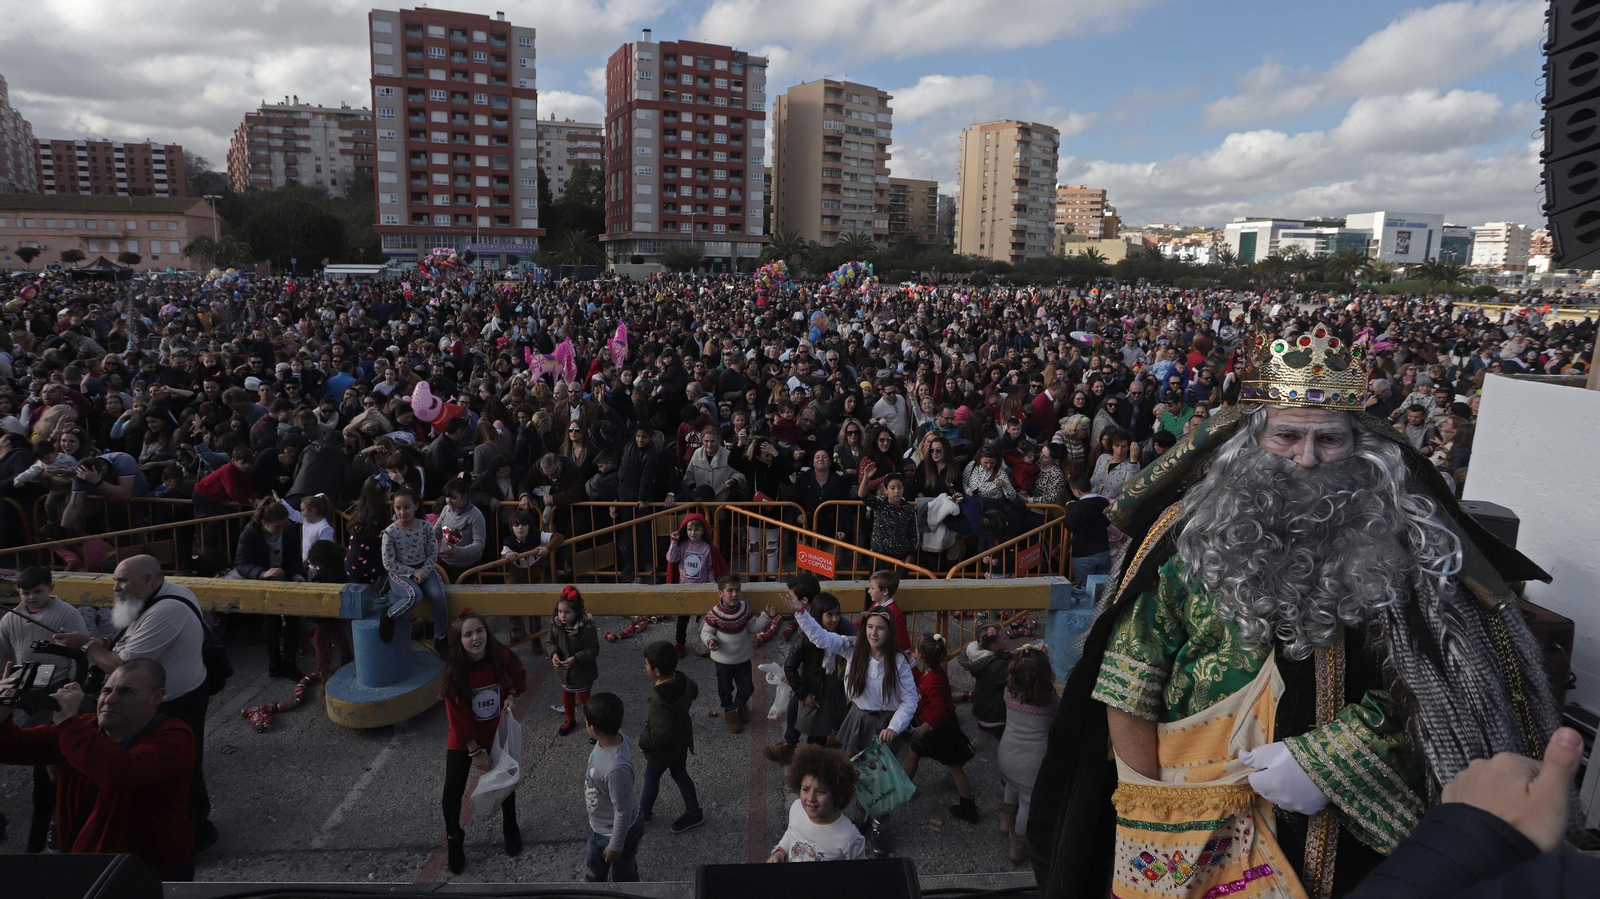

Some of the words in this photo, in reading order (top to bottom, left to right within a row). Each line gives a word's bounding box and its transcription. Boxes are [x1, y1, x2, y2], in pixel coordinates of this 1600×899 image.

[807, 554, 833, 566] INNOVIA
[807, 560, 833, 572] COPTALIA
[478, 699, 495, 708] 1982
